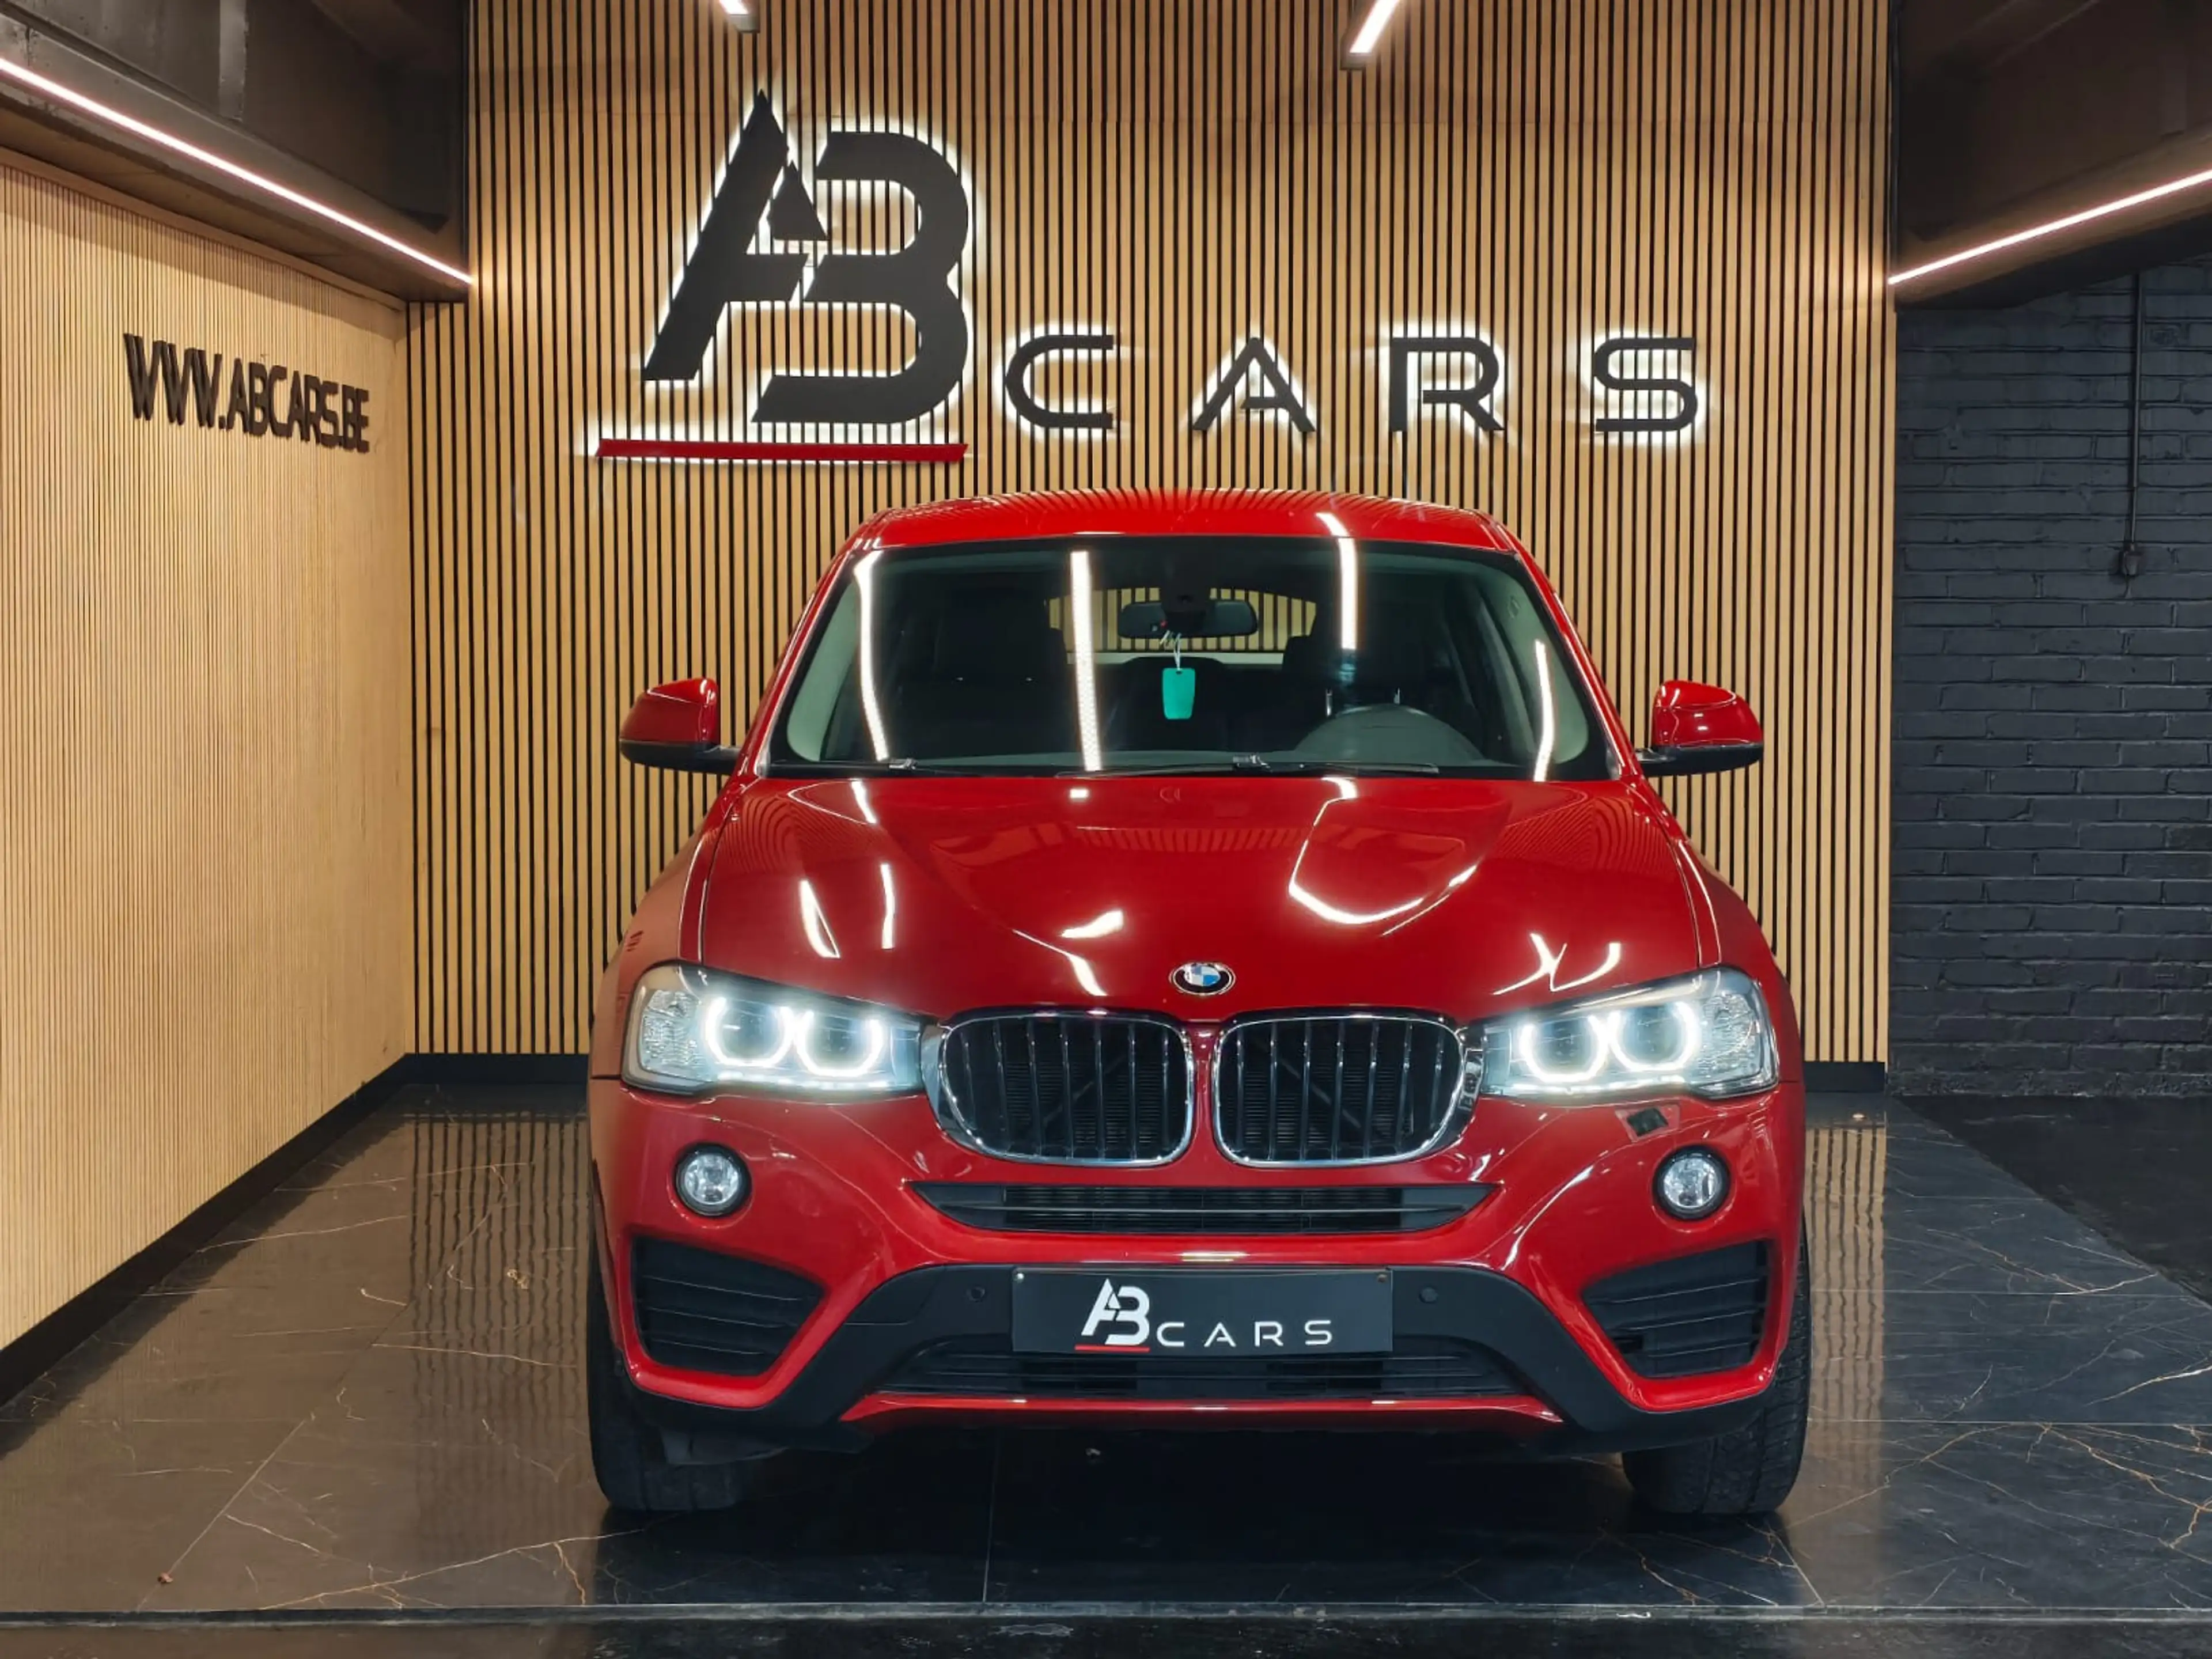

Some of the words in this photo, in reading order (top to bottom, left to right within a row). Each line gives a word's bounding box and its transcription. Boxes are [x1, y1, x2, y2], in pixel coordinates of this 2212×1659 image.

[641, 89, 969, 425] AB
[1005, 334, 1698, 432] CARS
[123, 333, 370, 454] WWW.ABCARS.BE
[1081, 1278, 1150, 1346] AB
[1157, 1320, 1333, 1347] CARS
